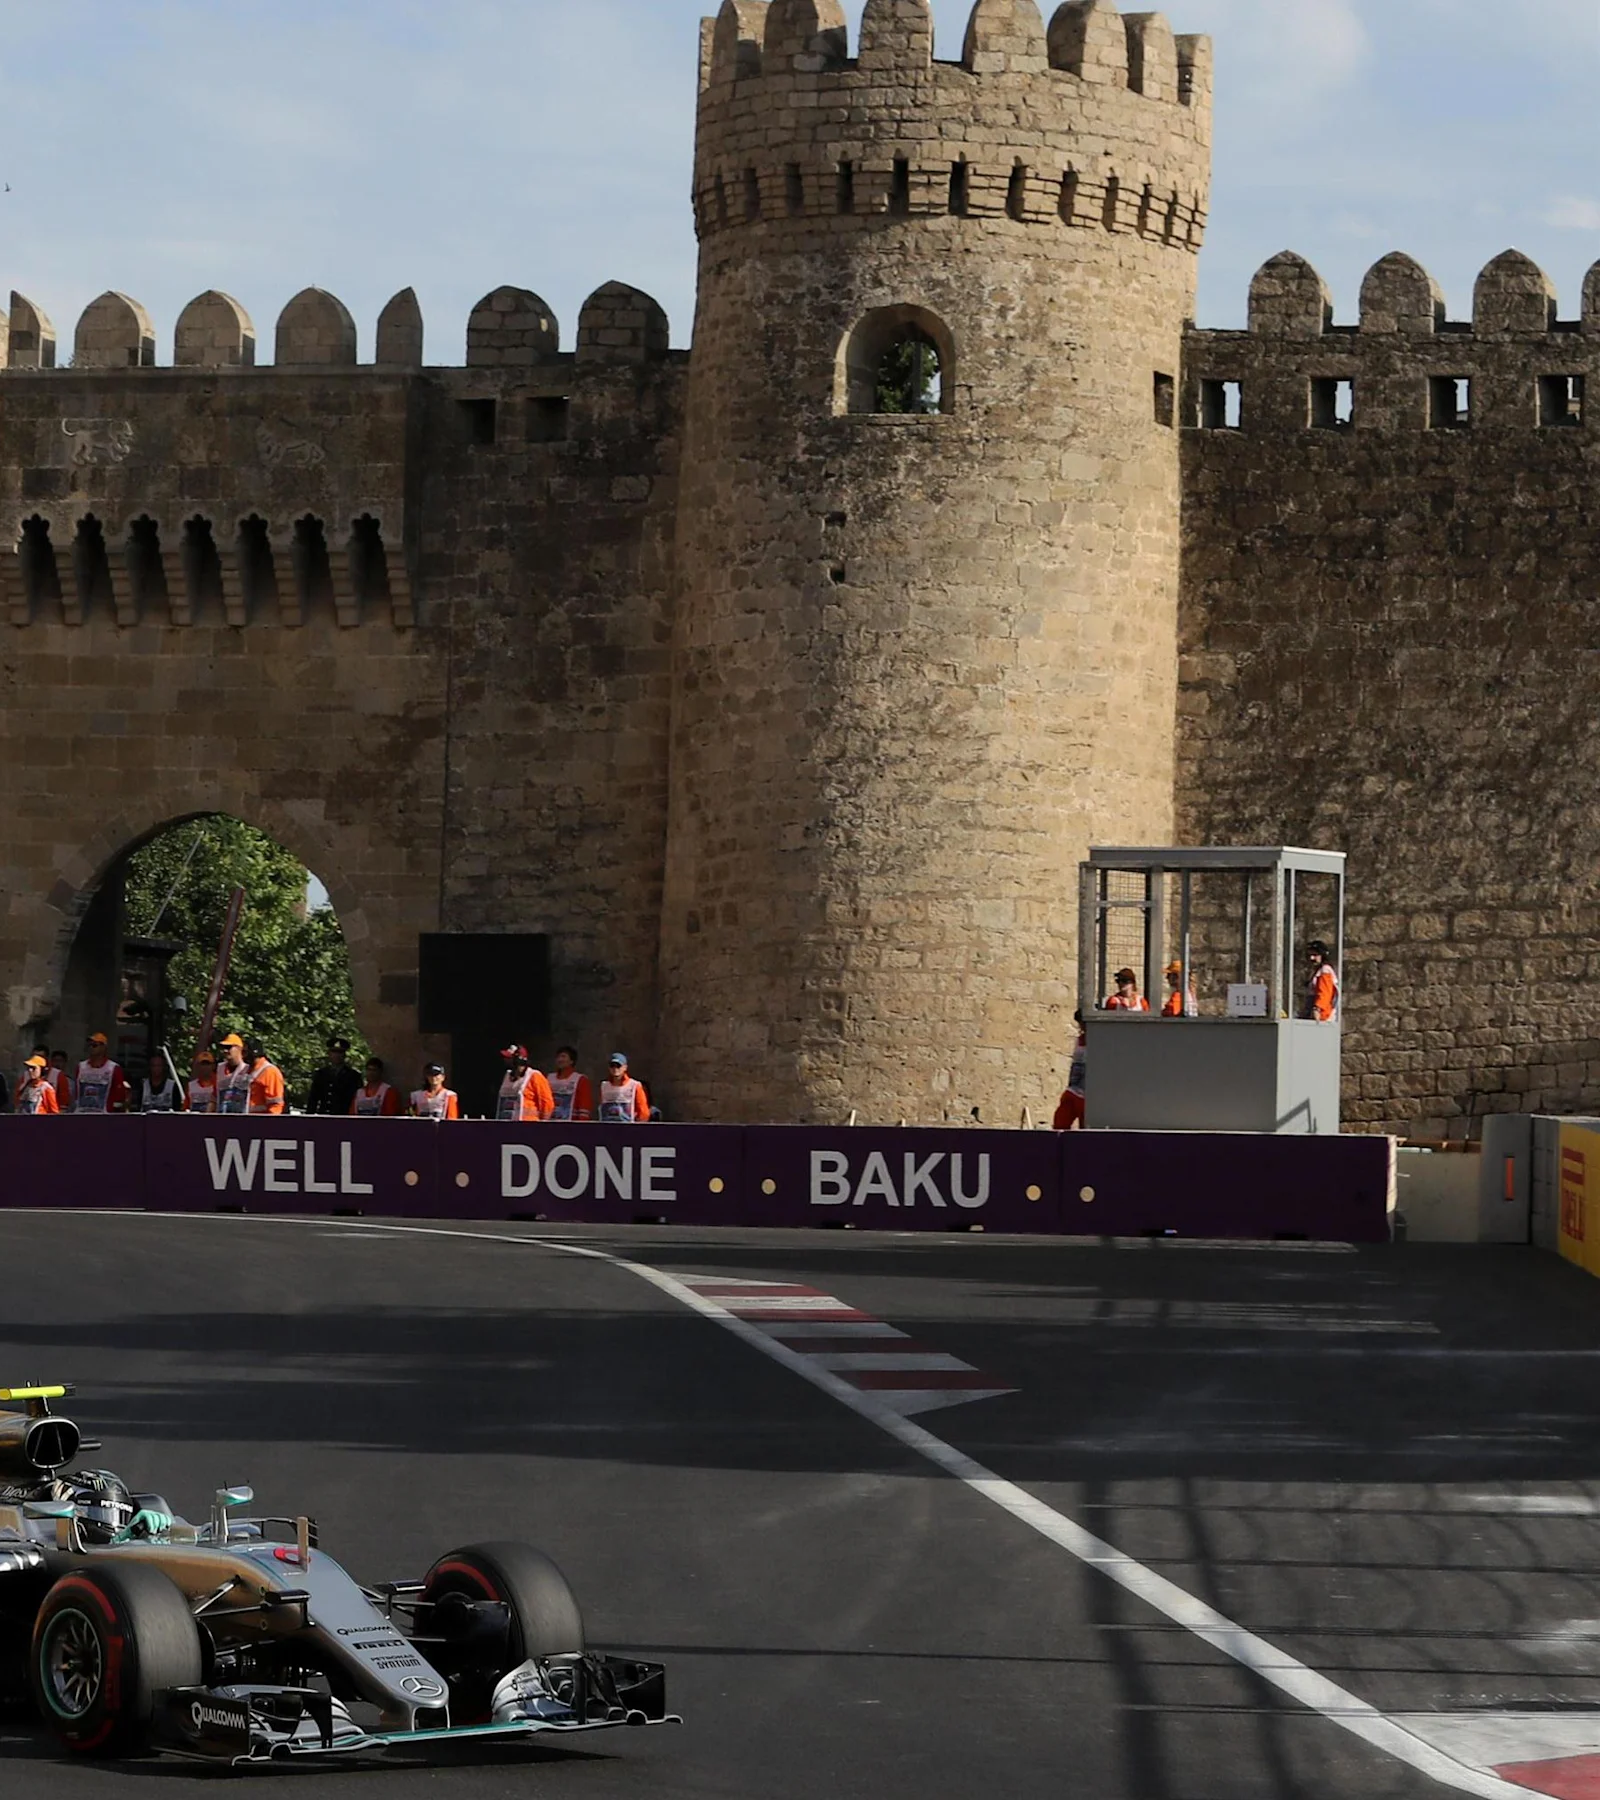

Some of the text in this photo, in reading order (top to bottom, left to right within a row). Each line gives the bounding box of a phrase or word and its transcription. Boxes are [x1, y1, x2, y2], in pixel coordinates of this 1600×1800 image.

[205, 1138, 990, 1207] WELL DONE BAKU
[377, 1659, 421, 1670] SYNTIUM
[191, 1701, 246, 1729] QUALCOMM
